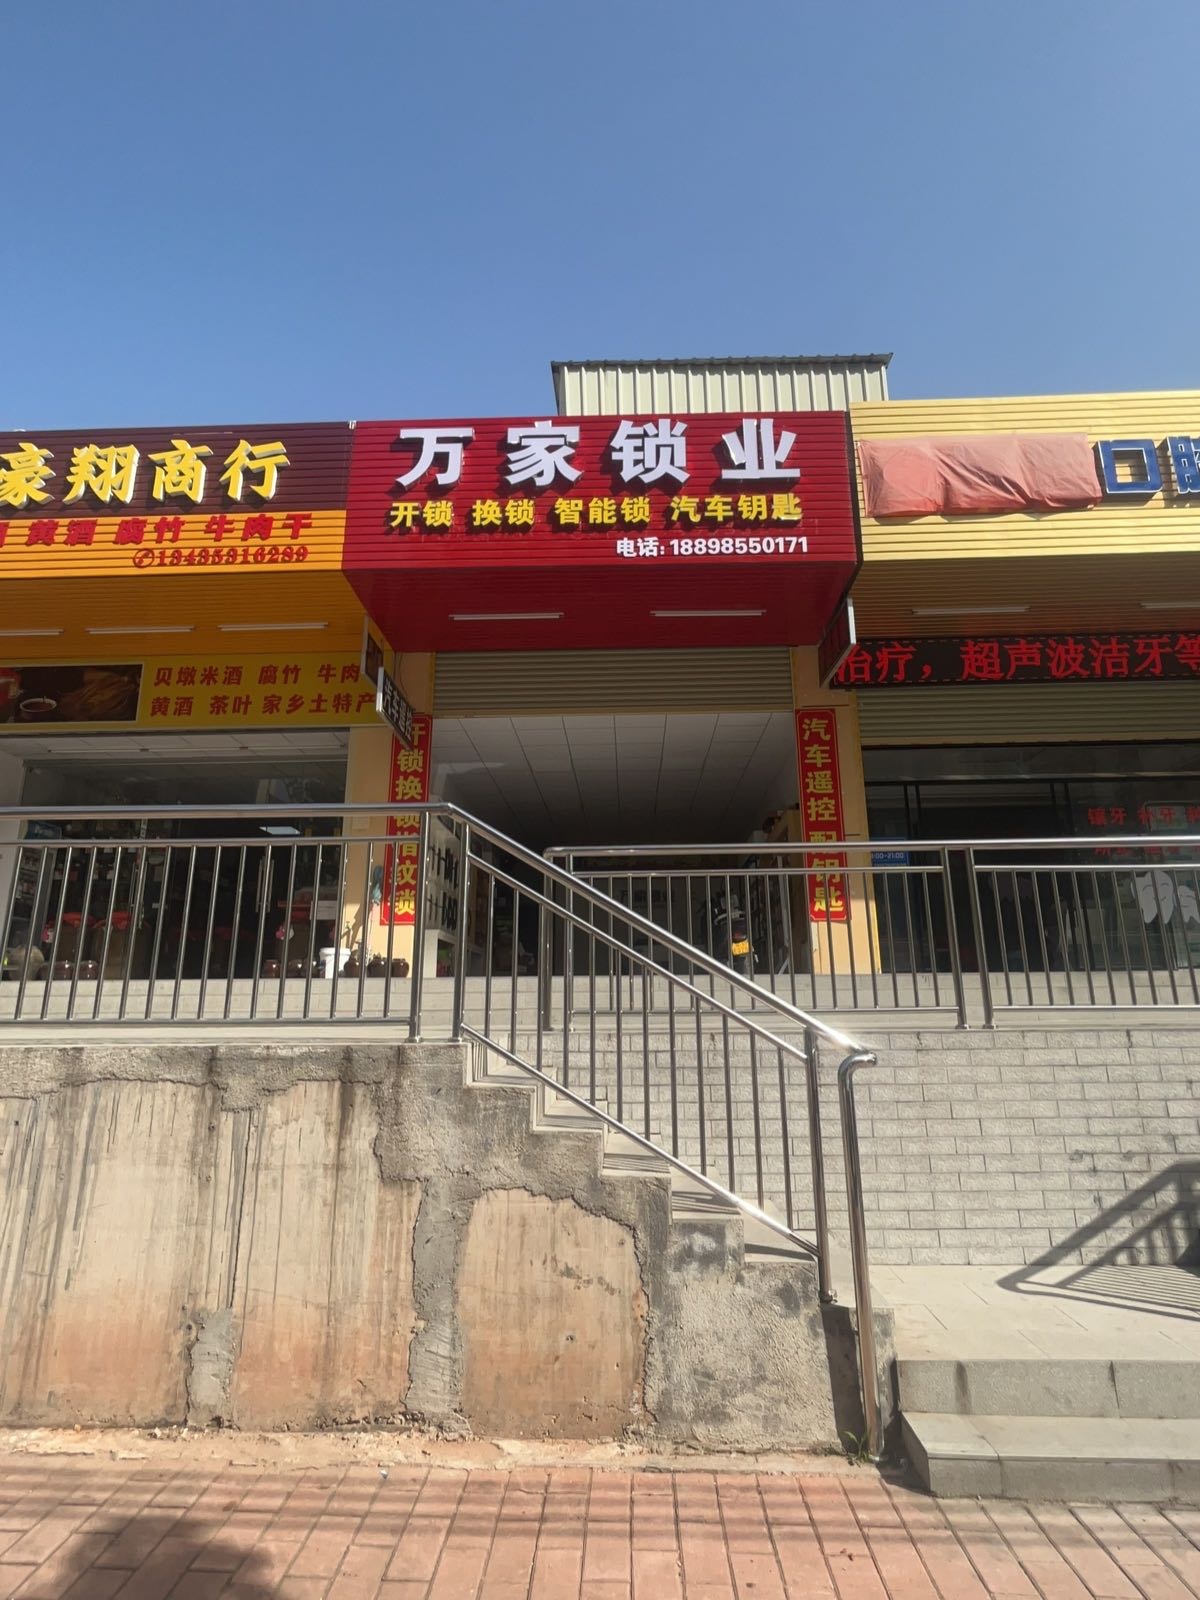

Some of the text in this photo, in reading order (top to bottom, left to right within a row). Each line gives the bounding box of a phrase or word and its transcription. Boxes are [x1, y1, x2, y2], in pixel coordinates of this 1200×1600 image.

[396, 418, 801, 489] 万家锁业
[0, 439, 290, 508] 豪翔商行
[390, 492, 804, 529] 开锁 换锁 智能锁 汽车钥匙
[25, 519, 98, 547] 黄酒
[113, 516, 185, 545] 腐竹
[203, 513, 313, 542] 牛肉干
[153, 665, 244, 687] 贝墩米酒
[258, 664, 302, 685] 腐竹
[150, 692, 377, 717] 黄酒 茶叶 家乡土特产
